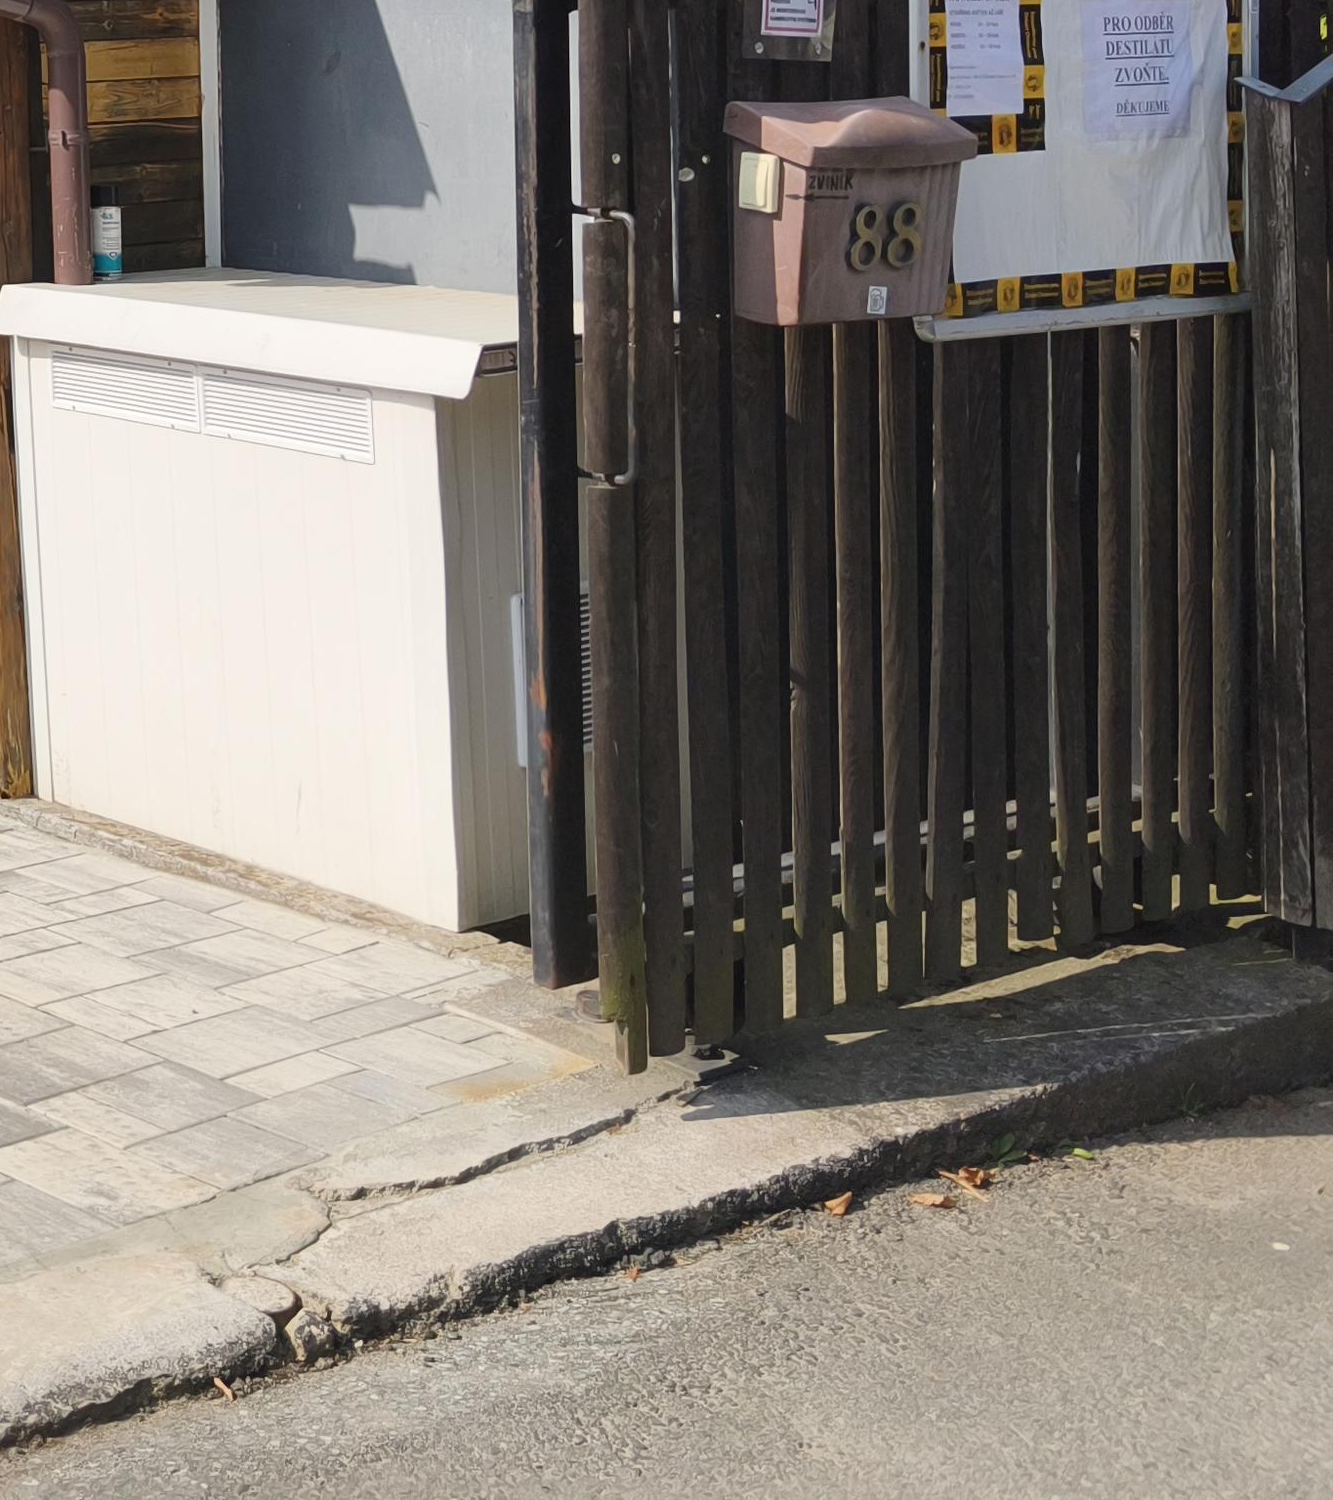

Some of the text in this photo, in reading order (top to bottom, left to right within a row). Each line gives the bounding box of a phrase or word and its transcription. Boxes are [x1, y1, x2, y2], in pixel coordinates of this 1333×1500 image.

[1103, 11, 1174, 32] PRO ODBĚR
[1116, 99, 1170, 114] DĚKUJEME
[851, 202, 923, 271] 88
